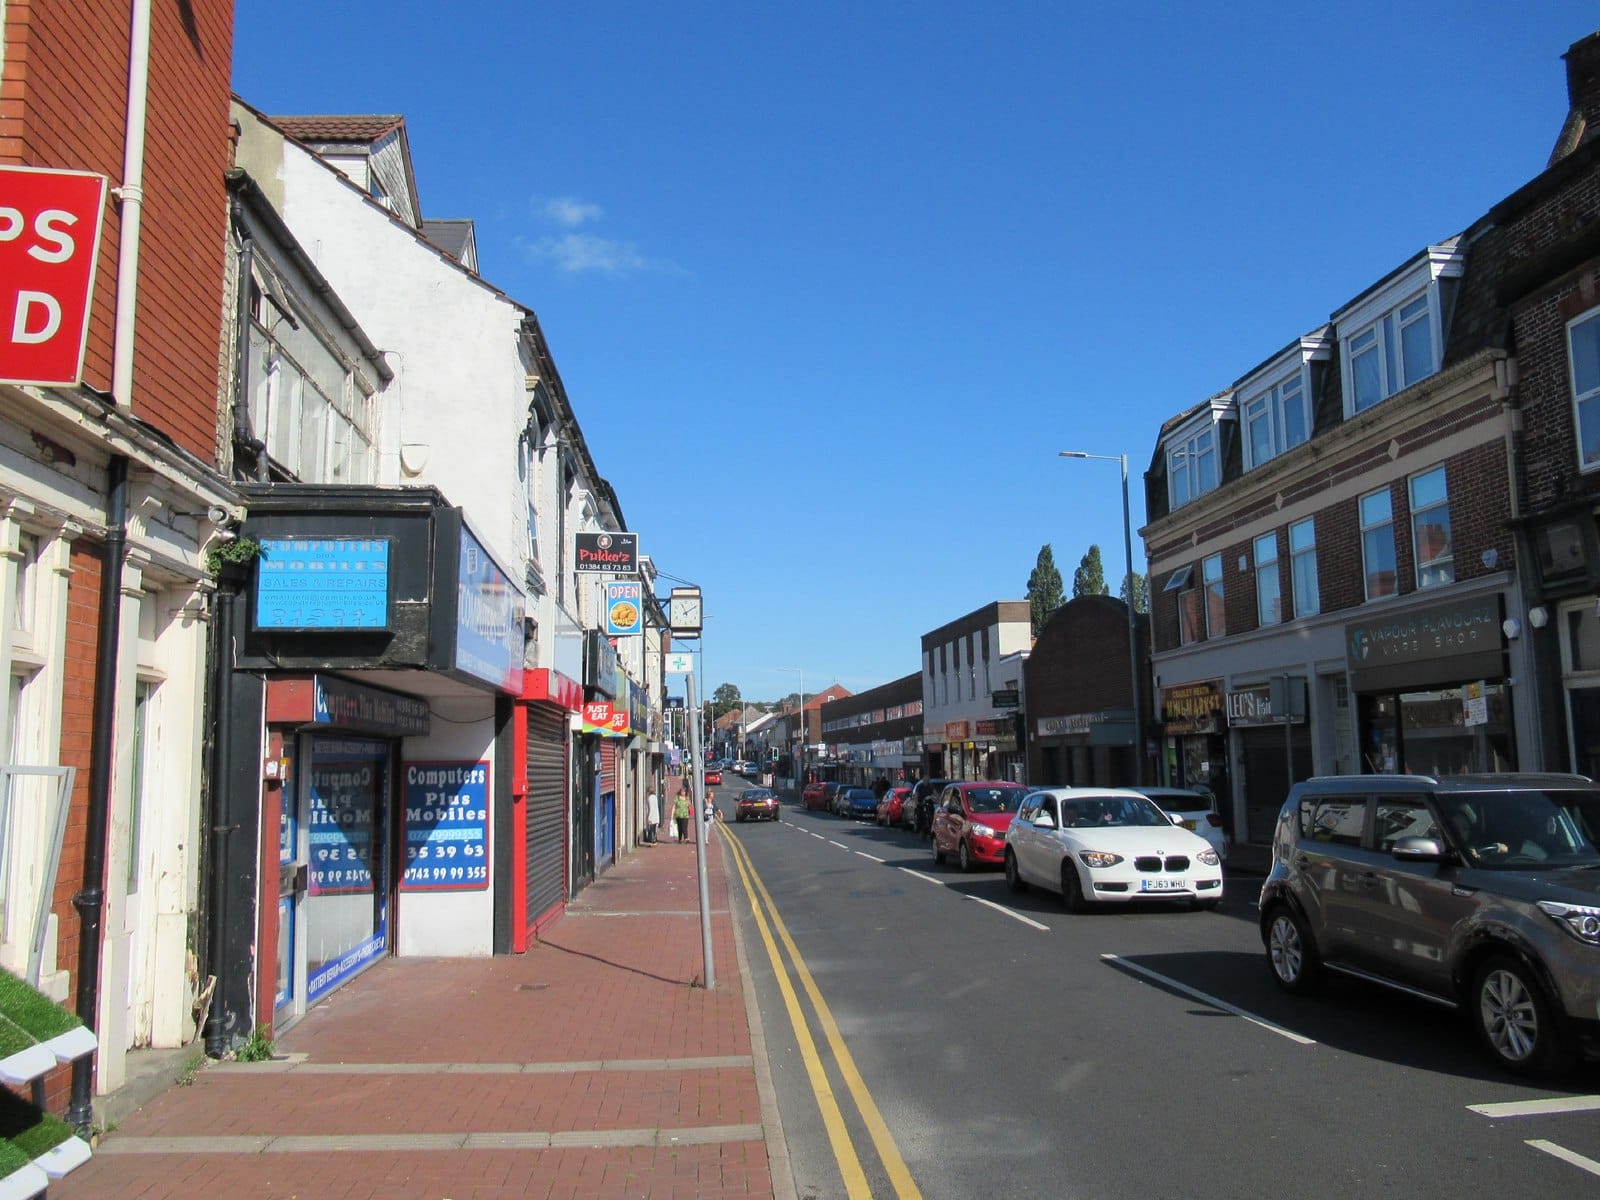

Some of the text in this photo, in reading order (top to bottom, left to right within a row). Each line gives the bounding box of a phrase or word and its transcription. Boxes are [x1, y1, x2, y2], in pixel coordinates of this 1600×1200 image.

[264, 578, 308, 588] SALES
[326, 579, 386, 589] REPAIRS
[609, 585, 638, 599] OPEN
[587, 704, 608, 714] JUST
[591, 713, 608, 721] EAT
[407, 766, 486, 788] Computers
[425, 792, 471, 806] Plus
[405, 807, 487, 822] Mobiles
[407, 844, 484, 859] 35 39 63
[404, 866, 487, 881] 0742 99 99 355
